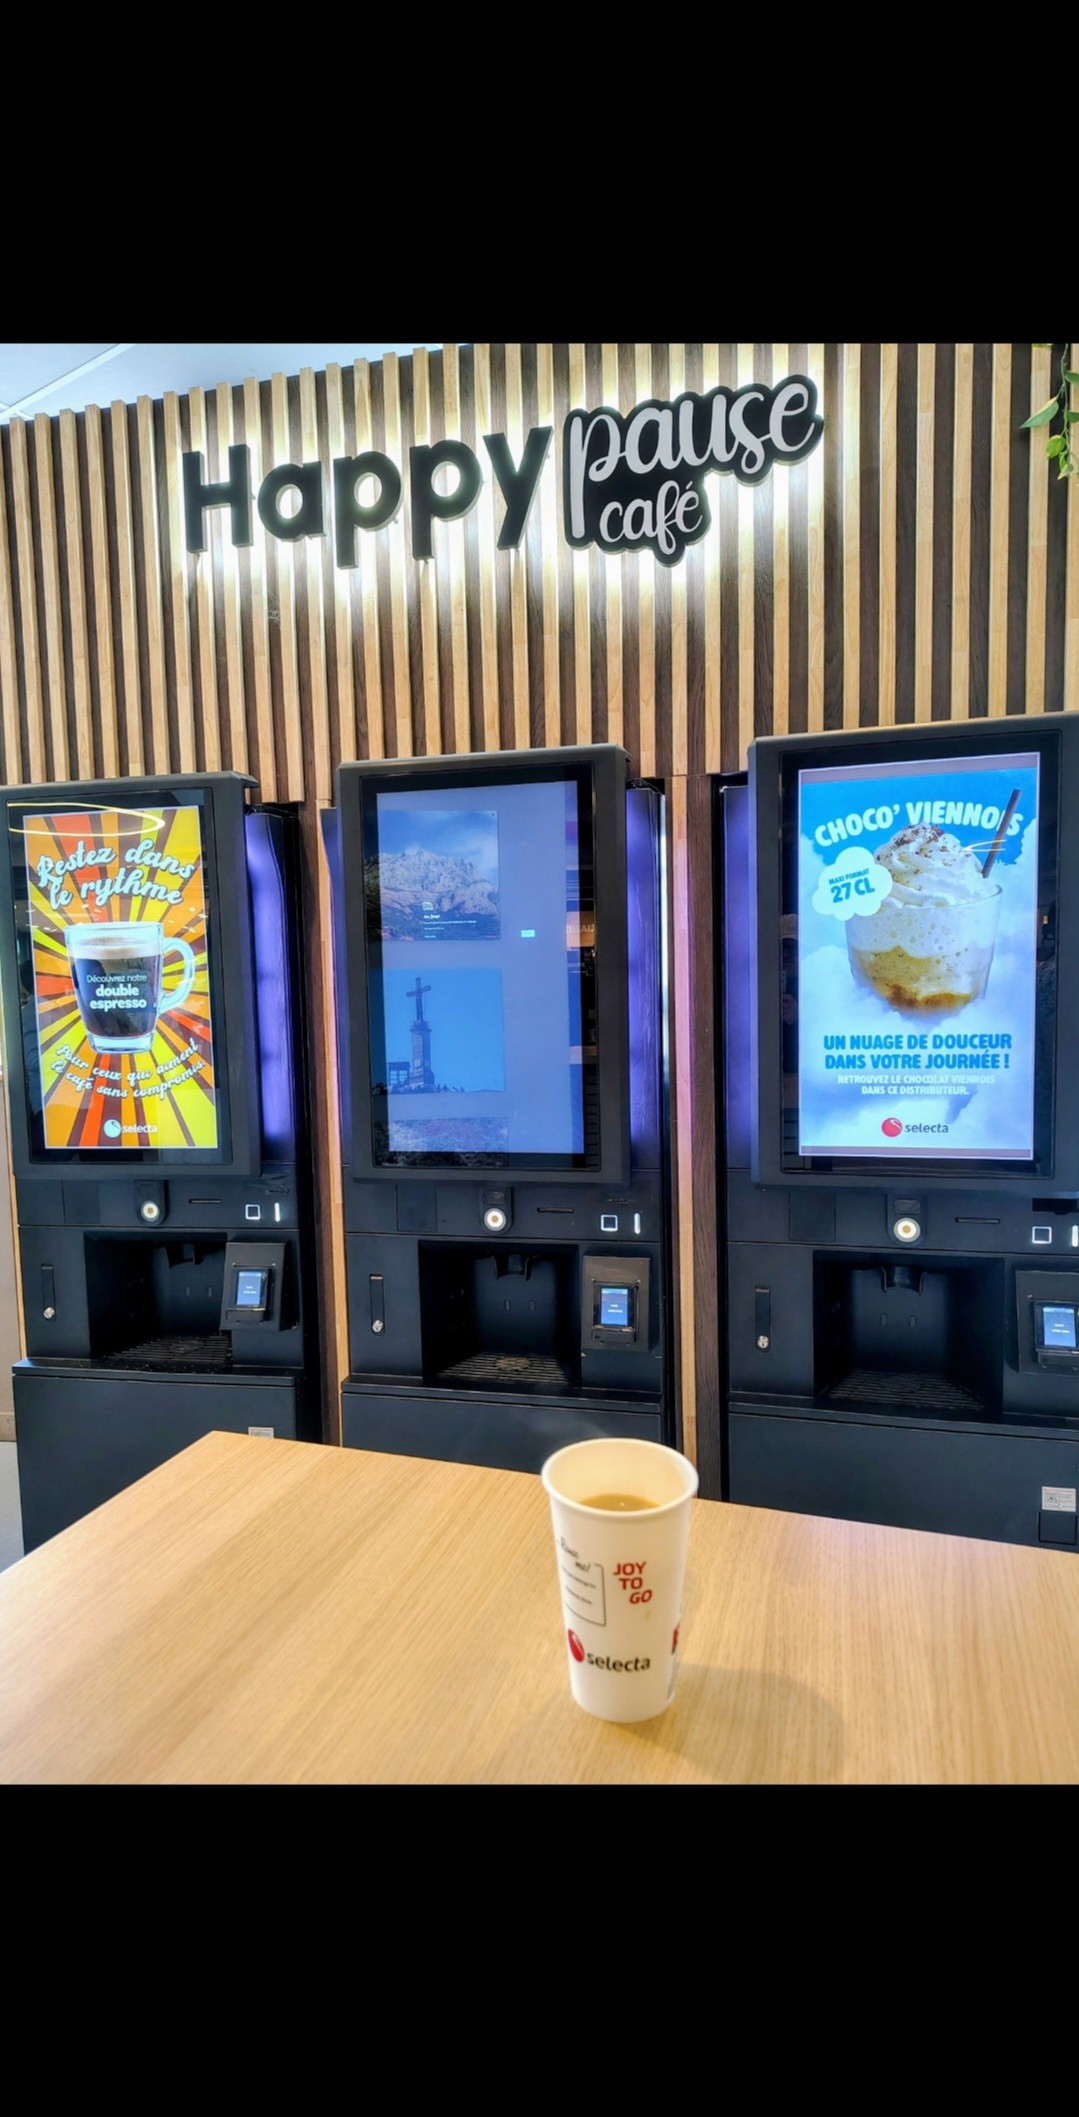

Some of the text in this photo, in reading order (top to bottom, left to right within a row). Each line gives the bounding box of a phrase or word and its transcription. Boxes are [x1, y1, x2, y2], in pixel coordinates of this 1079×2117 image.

[183, 381, 815, 569] Happy pause
[599, 480, 702, 555] café
[814, 803, 900, 847] CHOCO'
[37, 838, 196, 888] Restez dans
[829, 868, 869, 885] MAXI FORMAT
[49, 867, 184, 910] le rythme
[831, 877, 876, 903] 27 CL
[86, 974, 147, 984] Découvrez notre
[95, 983, 139, 997] double
[90, 999, 147, 1012] espresso
[823, 1033, 1012, 1050] UN NUAGE DE DOUCEUR
[56, 1037, 199, 1087] Pour ceux qui aiment
[825, 1050, 1010, 1070] DANS VOTRE JOURNÉE !
[51, 1059, 207, 1099] le café sans compromis.
[837, 1074, 996, 1084] RETROUVEZ LE CHOCOLAT VIENNOIS
[861, 1085, 970, 1095] DANS CE DISTRIBUTEUR.
[121, 1123, 158, 1134] selecta
[905, 1122, 949, 1134] selecta
[613, 1561, 647, 1577] JOY
[618, 1577, 643, 1591] TO
[629, 1589, 653, 1605] GO
[586, 1652, 651, 1674] selecta
